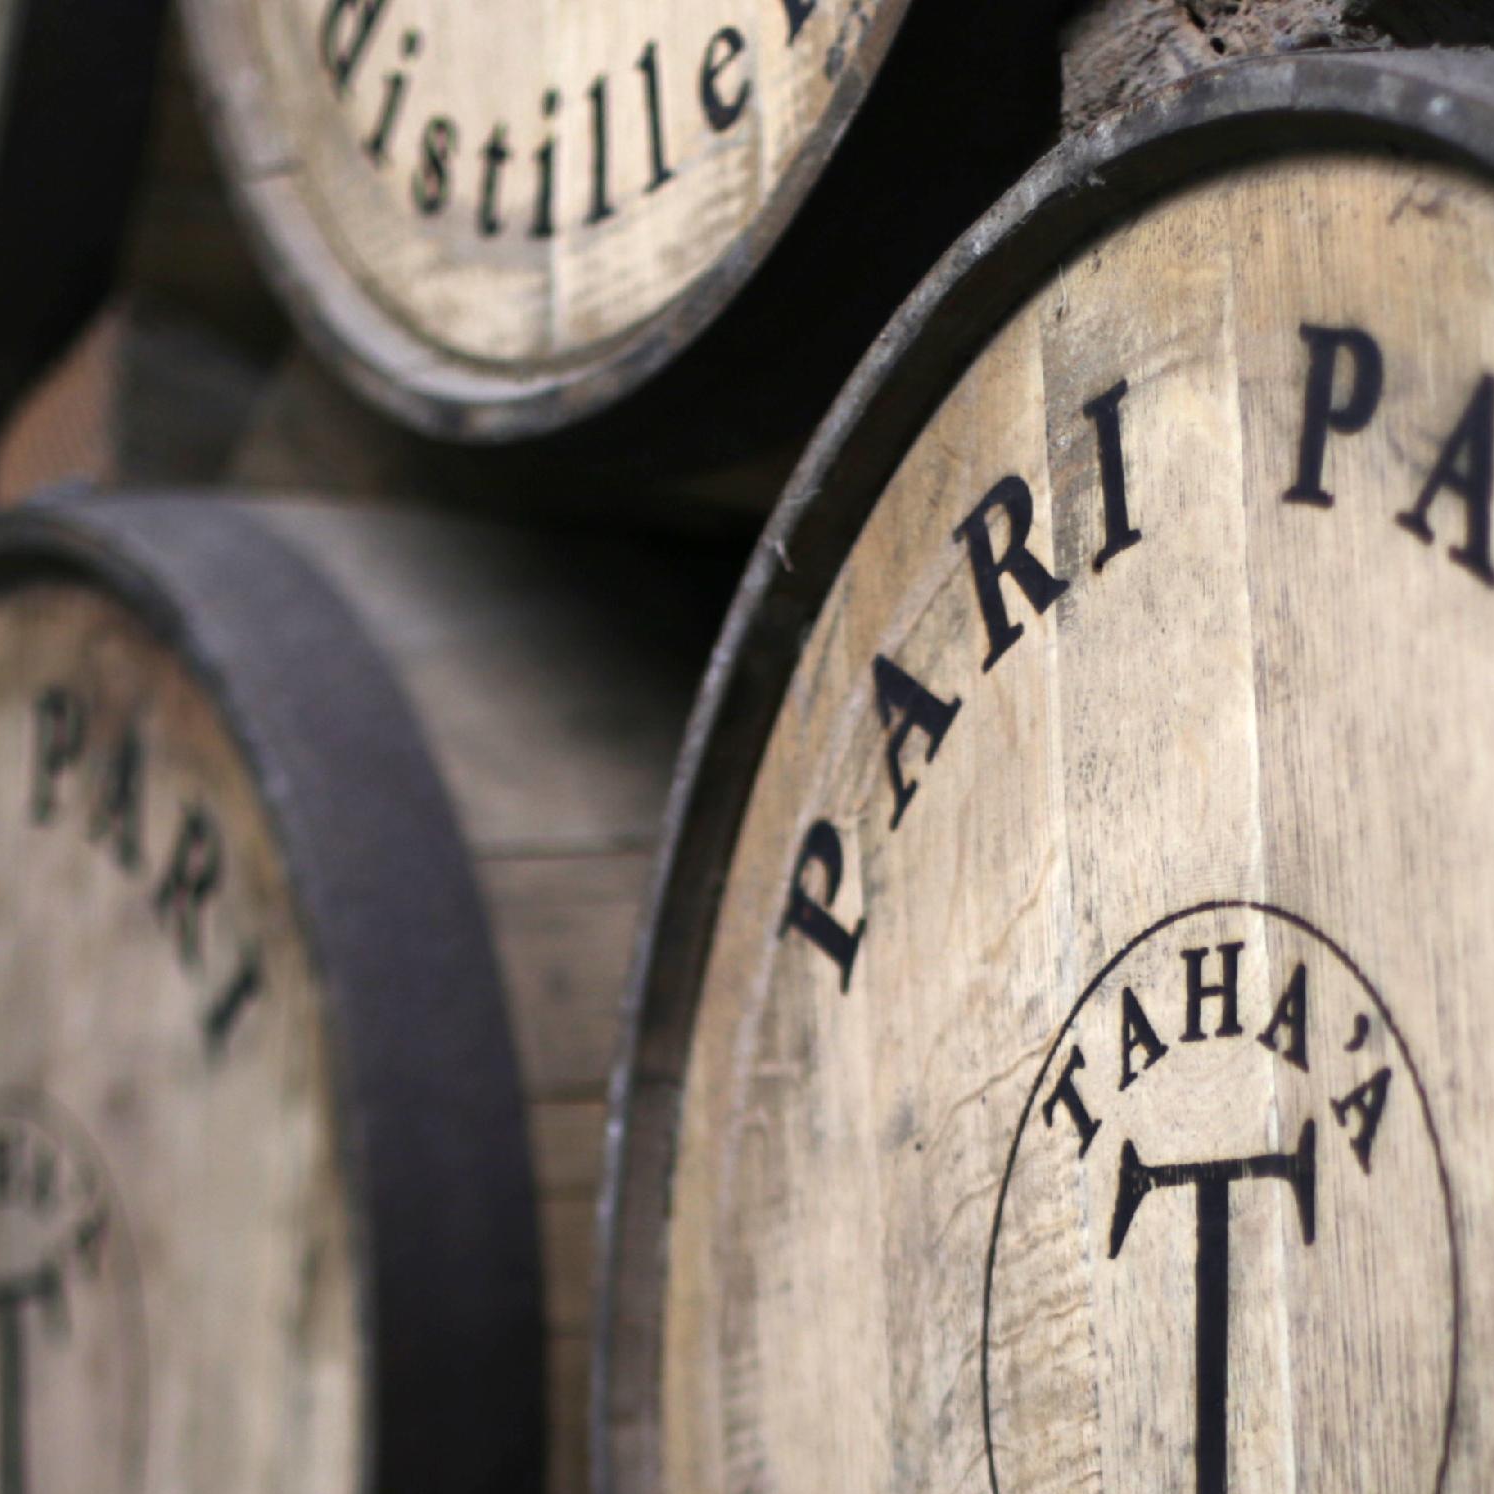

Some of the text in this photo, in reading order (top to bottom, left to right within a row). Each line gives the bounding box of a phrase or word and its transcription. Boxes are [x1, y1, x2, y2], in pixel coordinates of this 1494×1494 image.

[318, 0, 817, 240] distille
[779, 377, 1143, 997] PARI
[1041, 940, 1393, 1175] TAHA'A
